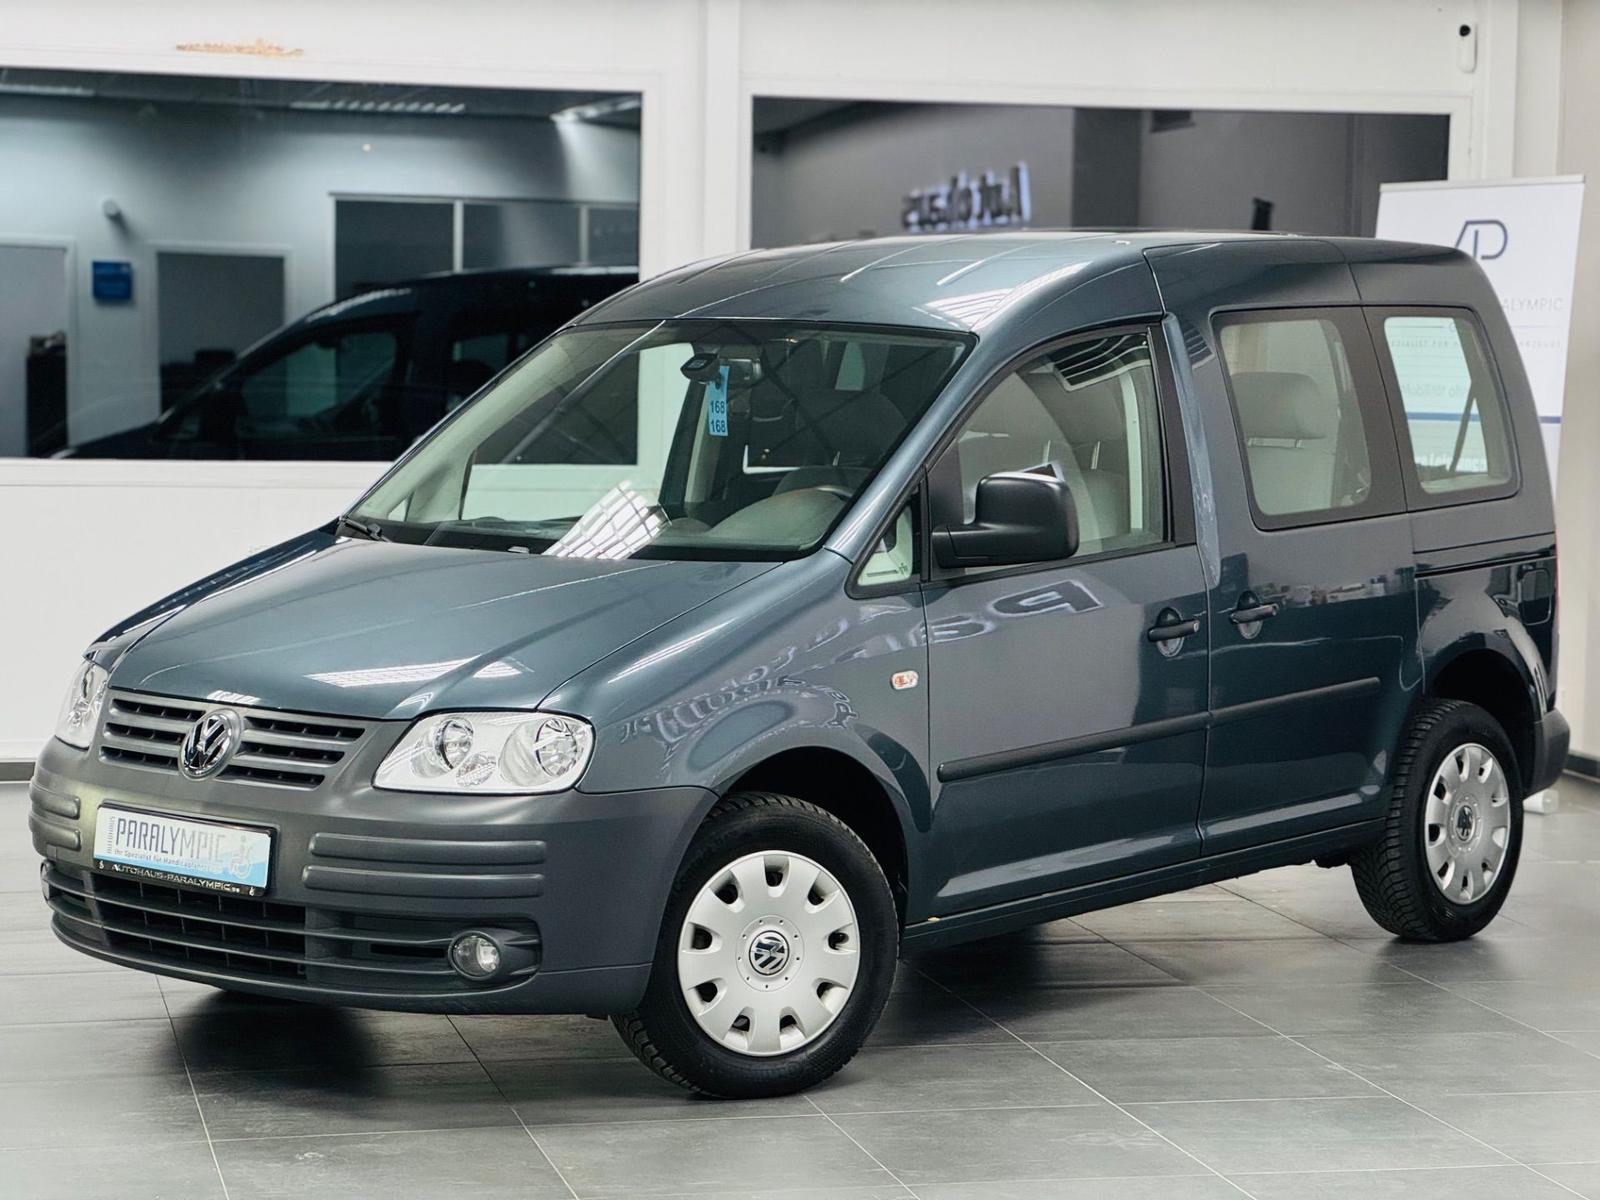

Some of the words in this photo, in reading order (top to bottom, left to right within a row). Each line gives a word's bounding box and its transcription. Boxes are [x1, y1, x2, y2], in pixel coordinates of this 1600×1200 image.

[1503, 297, 1563, 312] ALYMPIC
[709, 400, 726, 414] 168
[711, 420, 726, 433] 168
[115, 817, 226, 864] PARALYMPIC
